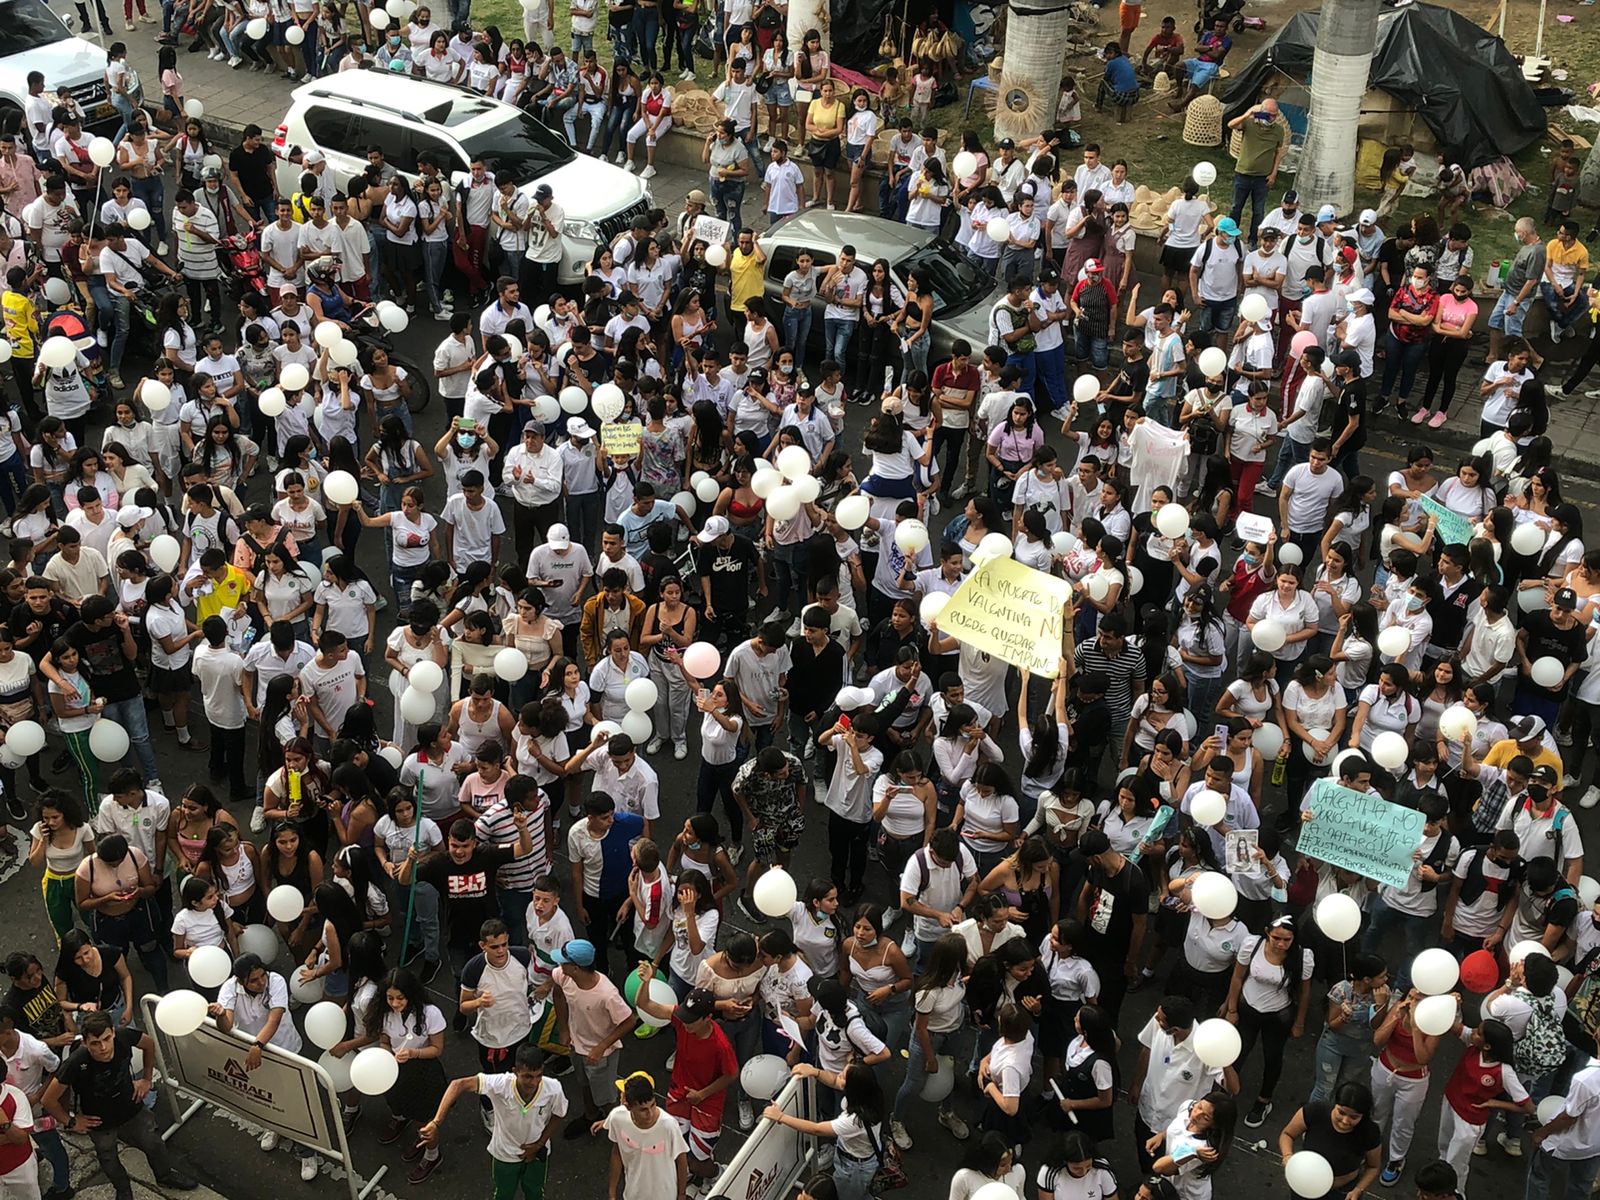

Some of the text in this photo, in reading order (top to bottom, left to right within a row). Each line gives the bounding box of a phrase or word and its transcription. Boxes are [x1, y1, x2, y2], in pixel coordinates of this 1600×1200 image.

[53, 384, 80, 392] adidas
[715, 556, 732, 565] JUST
[998, 579, 1042, 605] MUERTE
[968, 588, 1062, 641] VALENTINA NO
[950, 610, 1036, 651] PUEDE QUEDAR
[998, 644, 1050, 673] IMPUNE
[318, 671, 352, 687] MONASTERY
[1317, 784, 1418, 831] VALENTINA NO
[1358, 821, 1417, 849] VALENTINA
